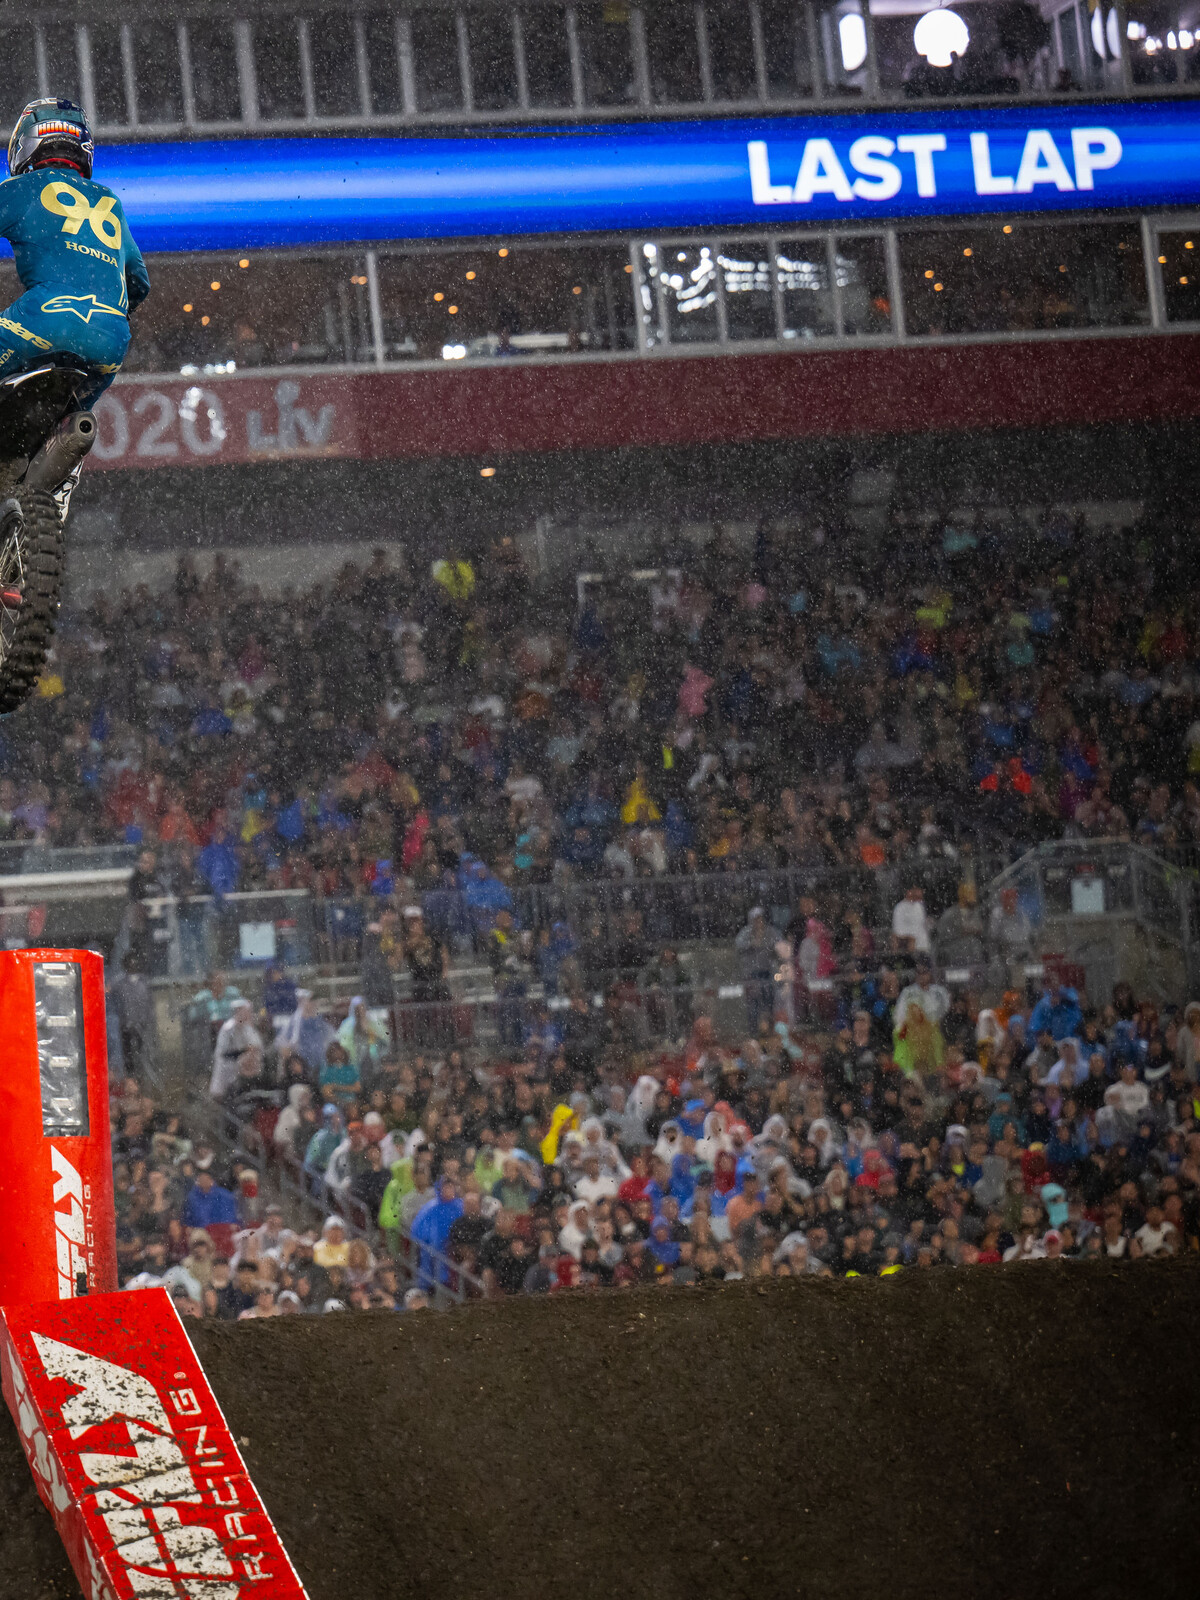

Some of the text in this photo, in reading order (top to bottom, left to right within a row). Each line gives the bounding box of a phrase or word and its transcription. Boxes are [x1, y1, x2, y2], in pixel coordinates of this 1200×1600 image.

[747, 127, 1123, 205] LAST LAP
[40, 181, 122, 250] 96
[65, 240, 119, 268] HONDA
[89, 385, 227, 460] 020
[83, 1183, 97, 1287] RACING
[169, 1387, 273, 1582] RACING
